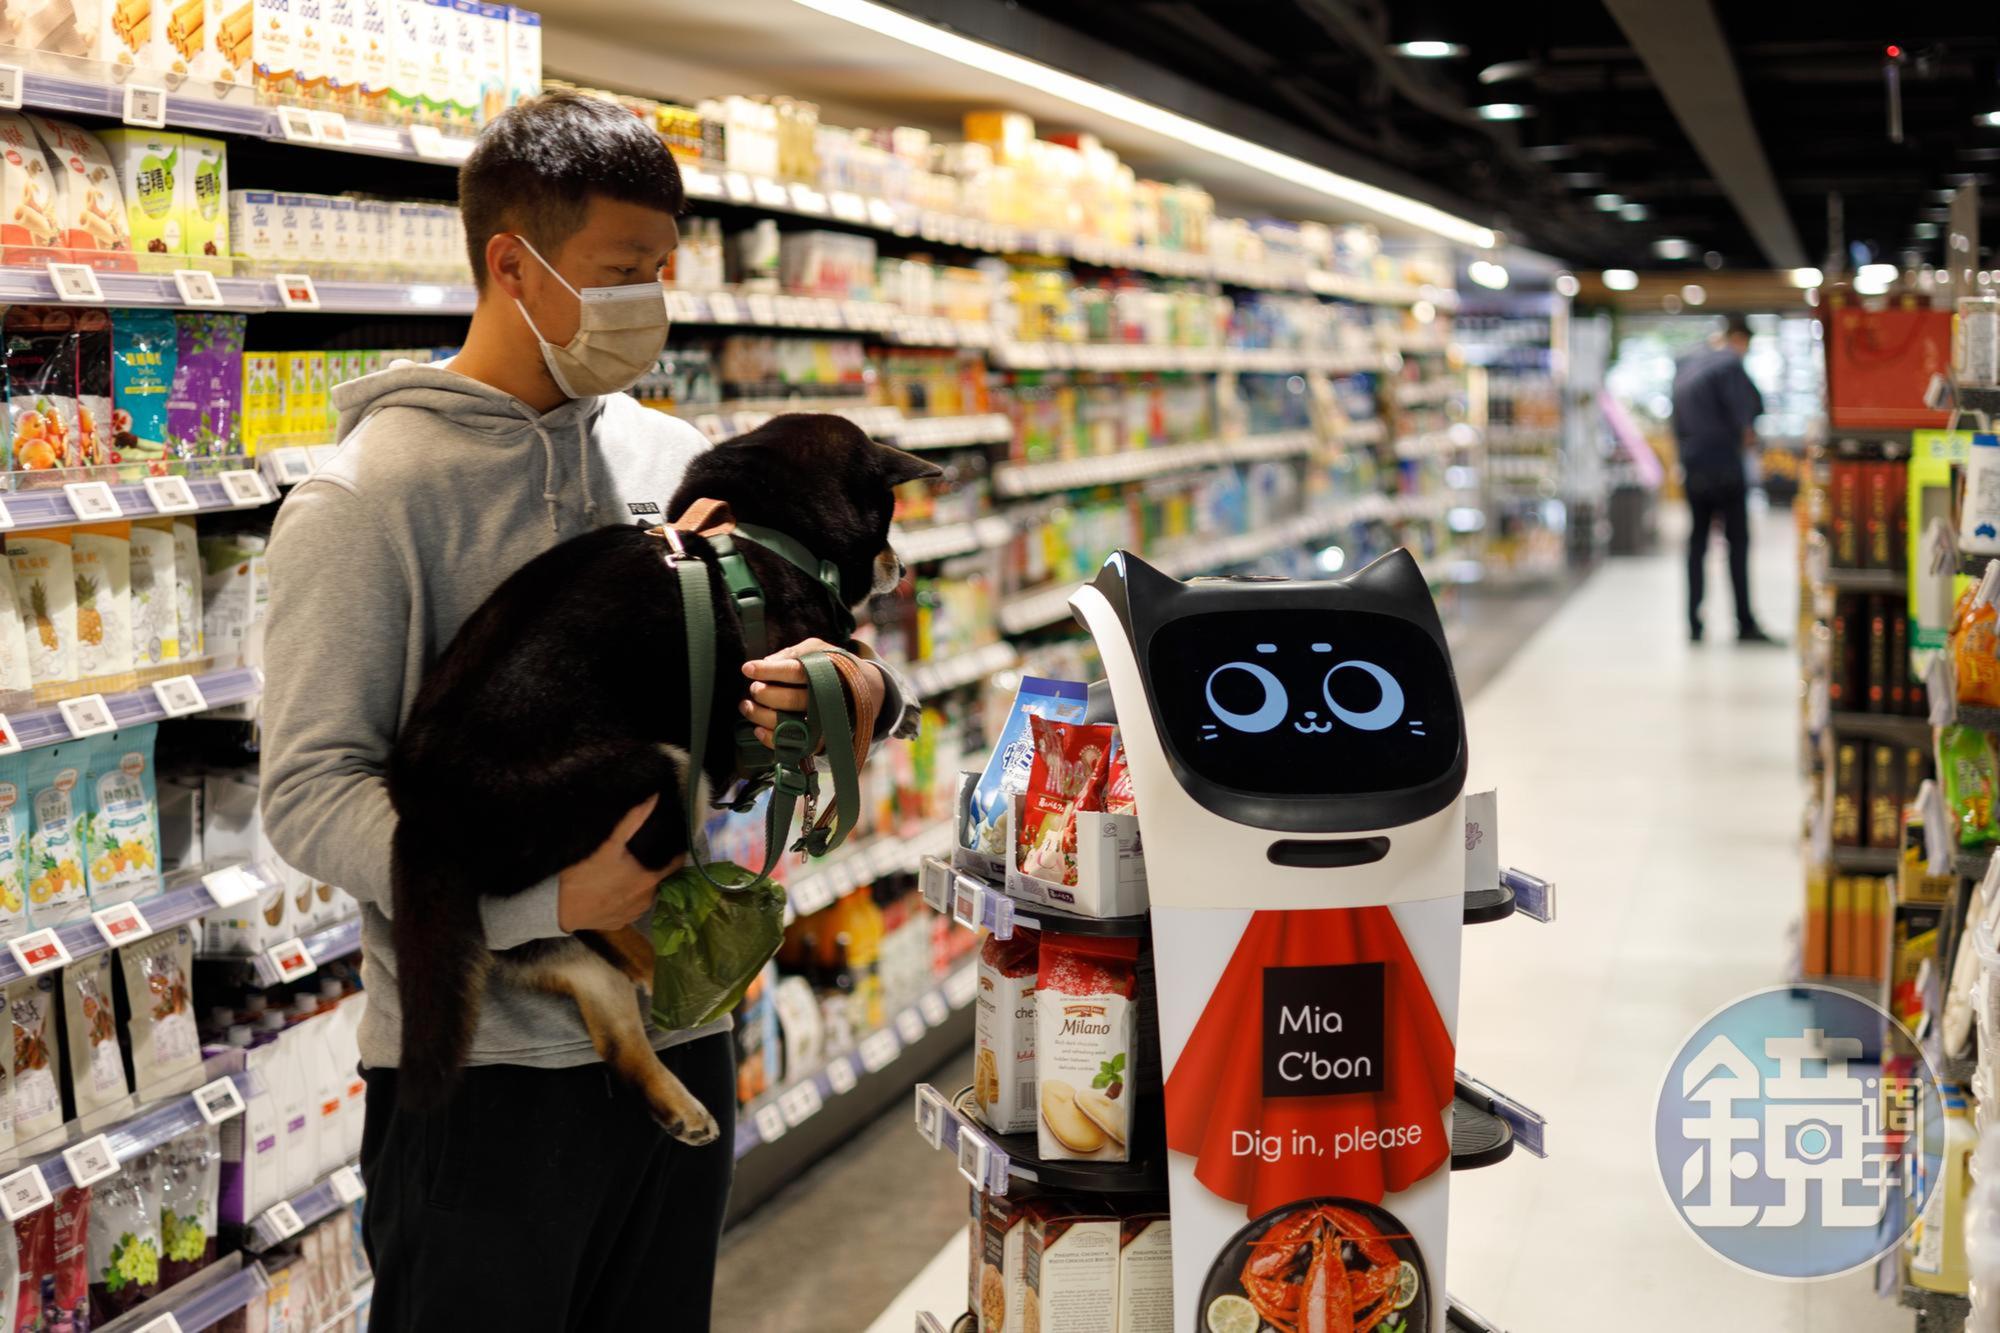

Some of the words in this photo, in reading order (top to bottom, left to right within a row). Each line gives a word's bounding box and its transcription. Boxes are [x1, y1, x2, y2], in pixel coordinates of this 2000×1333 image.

[1058, 1019, 1111, 1036] Milano
[1278, 1005, 1343, 1035] Mia
[1278, 1051, 1372, 1081] C'bon
[1231, 1130, 1282, 1162] Dig
[1292, 1129, 1324, 1157] in,
[1335, 1124, 1422, 1159] please
